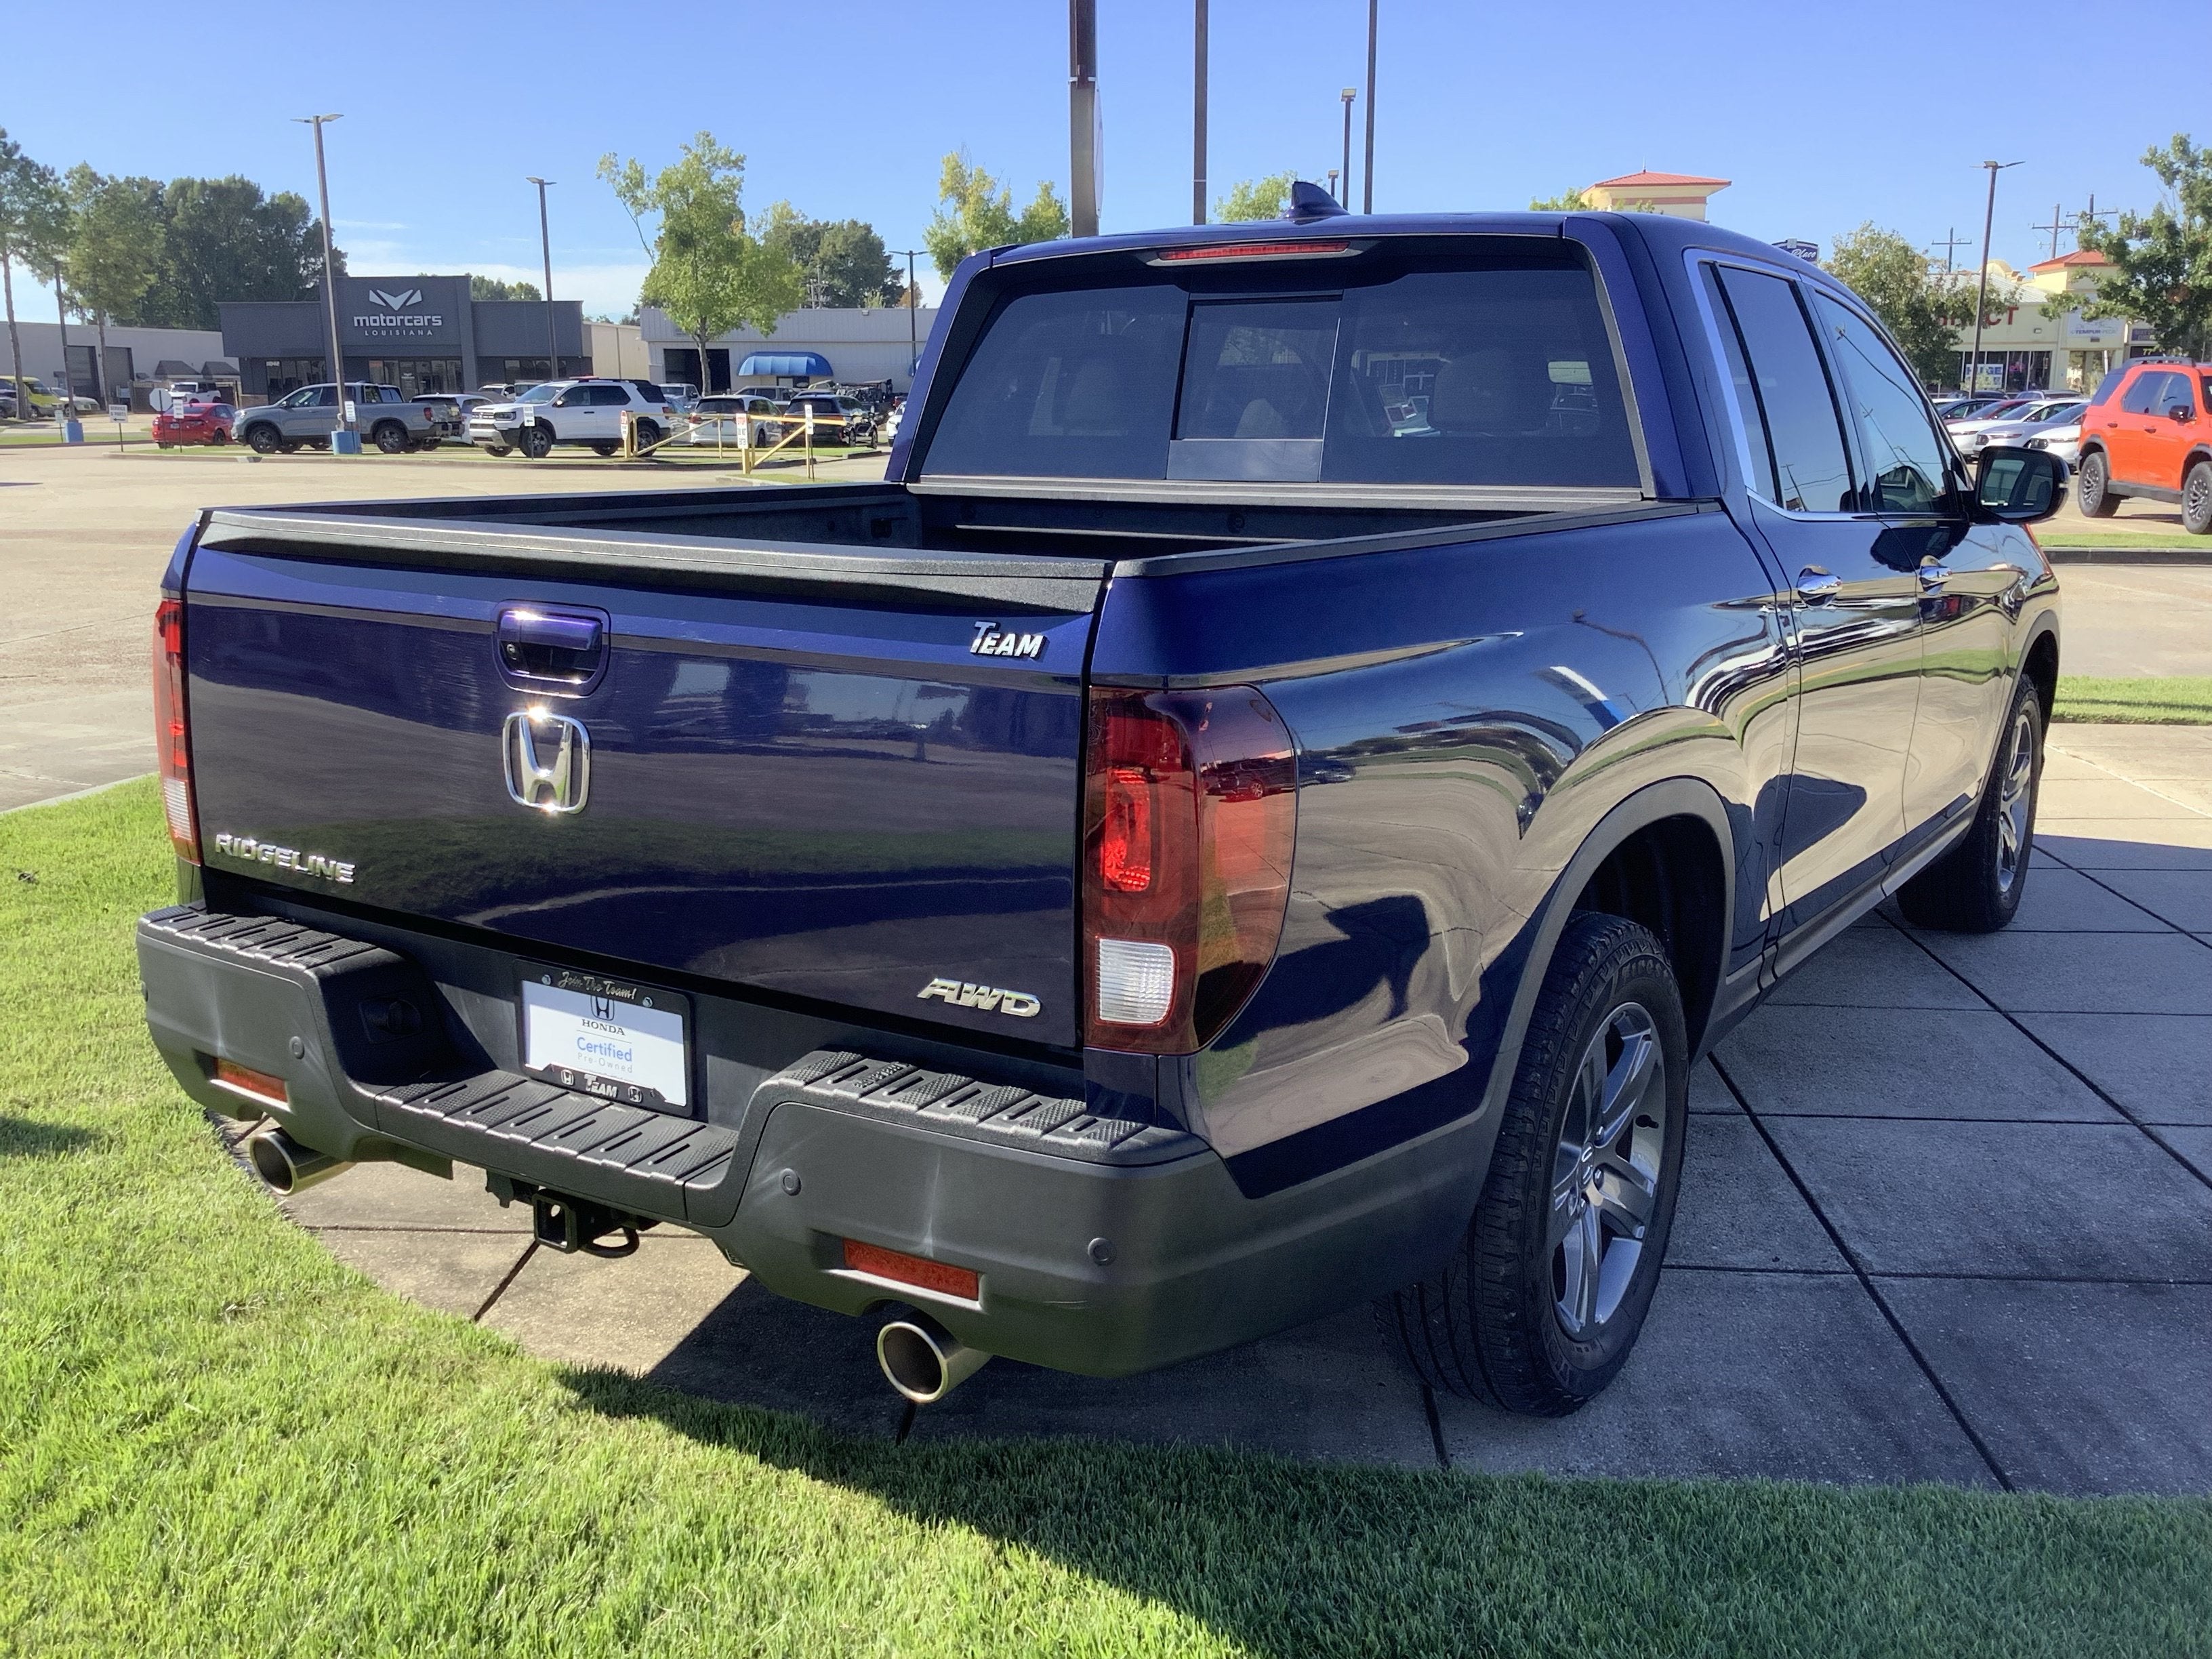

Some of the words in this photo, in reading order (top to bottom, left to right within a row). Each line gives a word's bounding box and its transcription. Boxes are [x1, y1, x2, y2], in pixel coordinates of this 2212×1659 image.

[353, 313, 443, 327] motorcars
[970, 621, 1044, 659] TEAM
[215, 834, 356, 884] RIDGELINE
[917, 978, 1041, 1017] AWD
[581, 1019, 626, 1036] HONDA
[577, 1037, 633, 1062] Certified
[577, 1052, 633, 1073] Pre-Owned
[583, 1073, 617, 1097] TEAM
